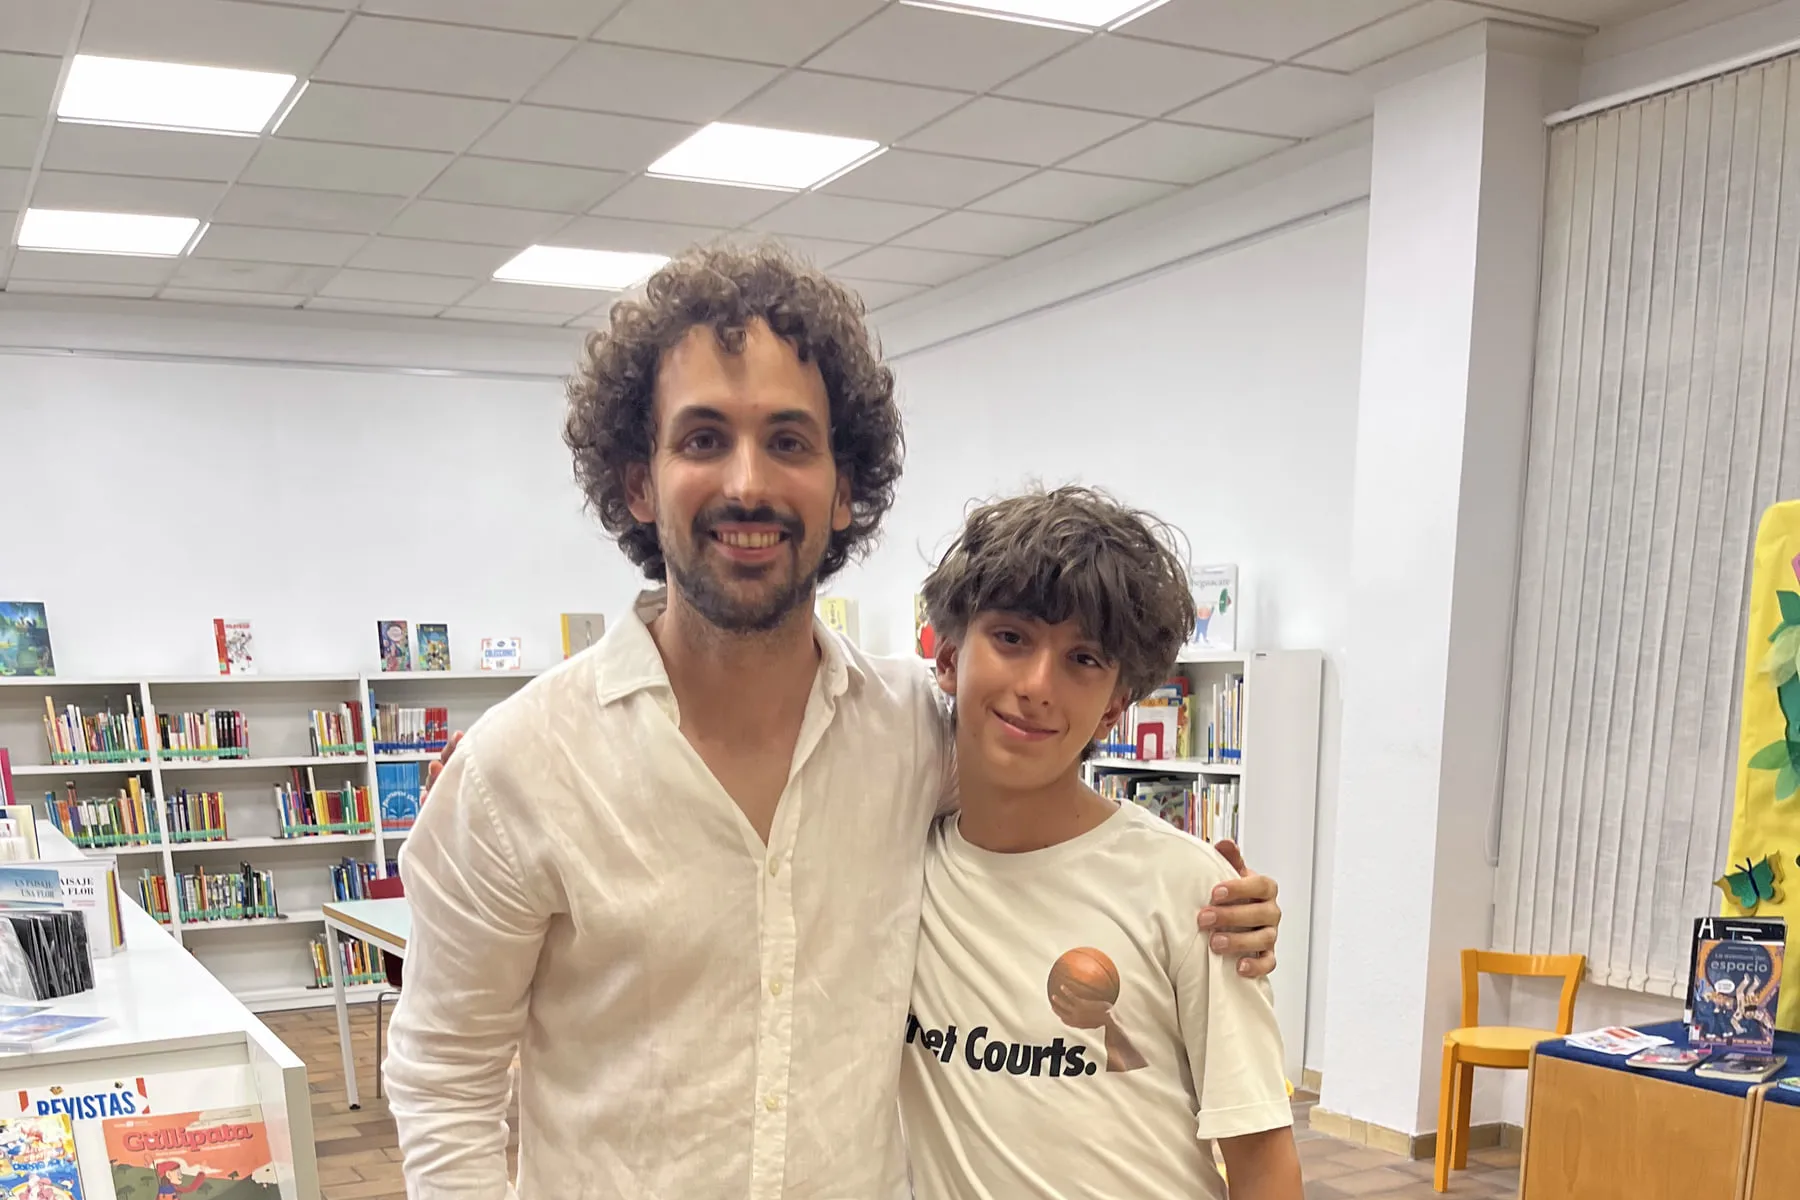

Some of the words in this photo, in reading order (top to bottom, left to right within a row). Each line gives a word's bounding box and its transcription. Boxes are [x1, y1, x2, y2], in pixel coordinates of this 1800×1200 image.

[68, 888, 94, 896] FLOR
[1711, 959, 1768, 973] espacio
[965, 1026, 1097, 1078] Courts.
[37, 1091, 136, 1120] REVISTAS
